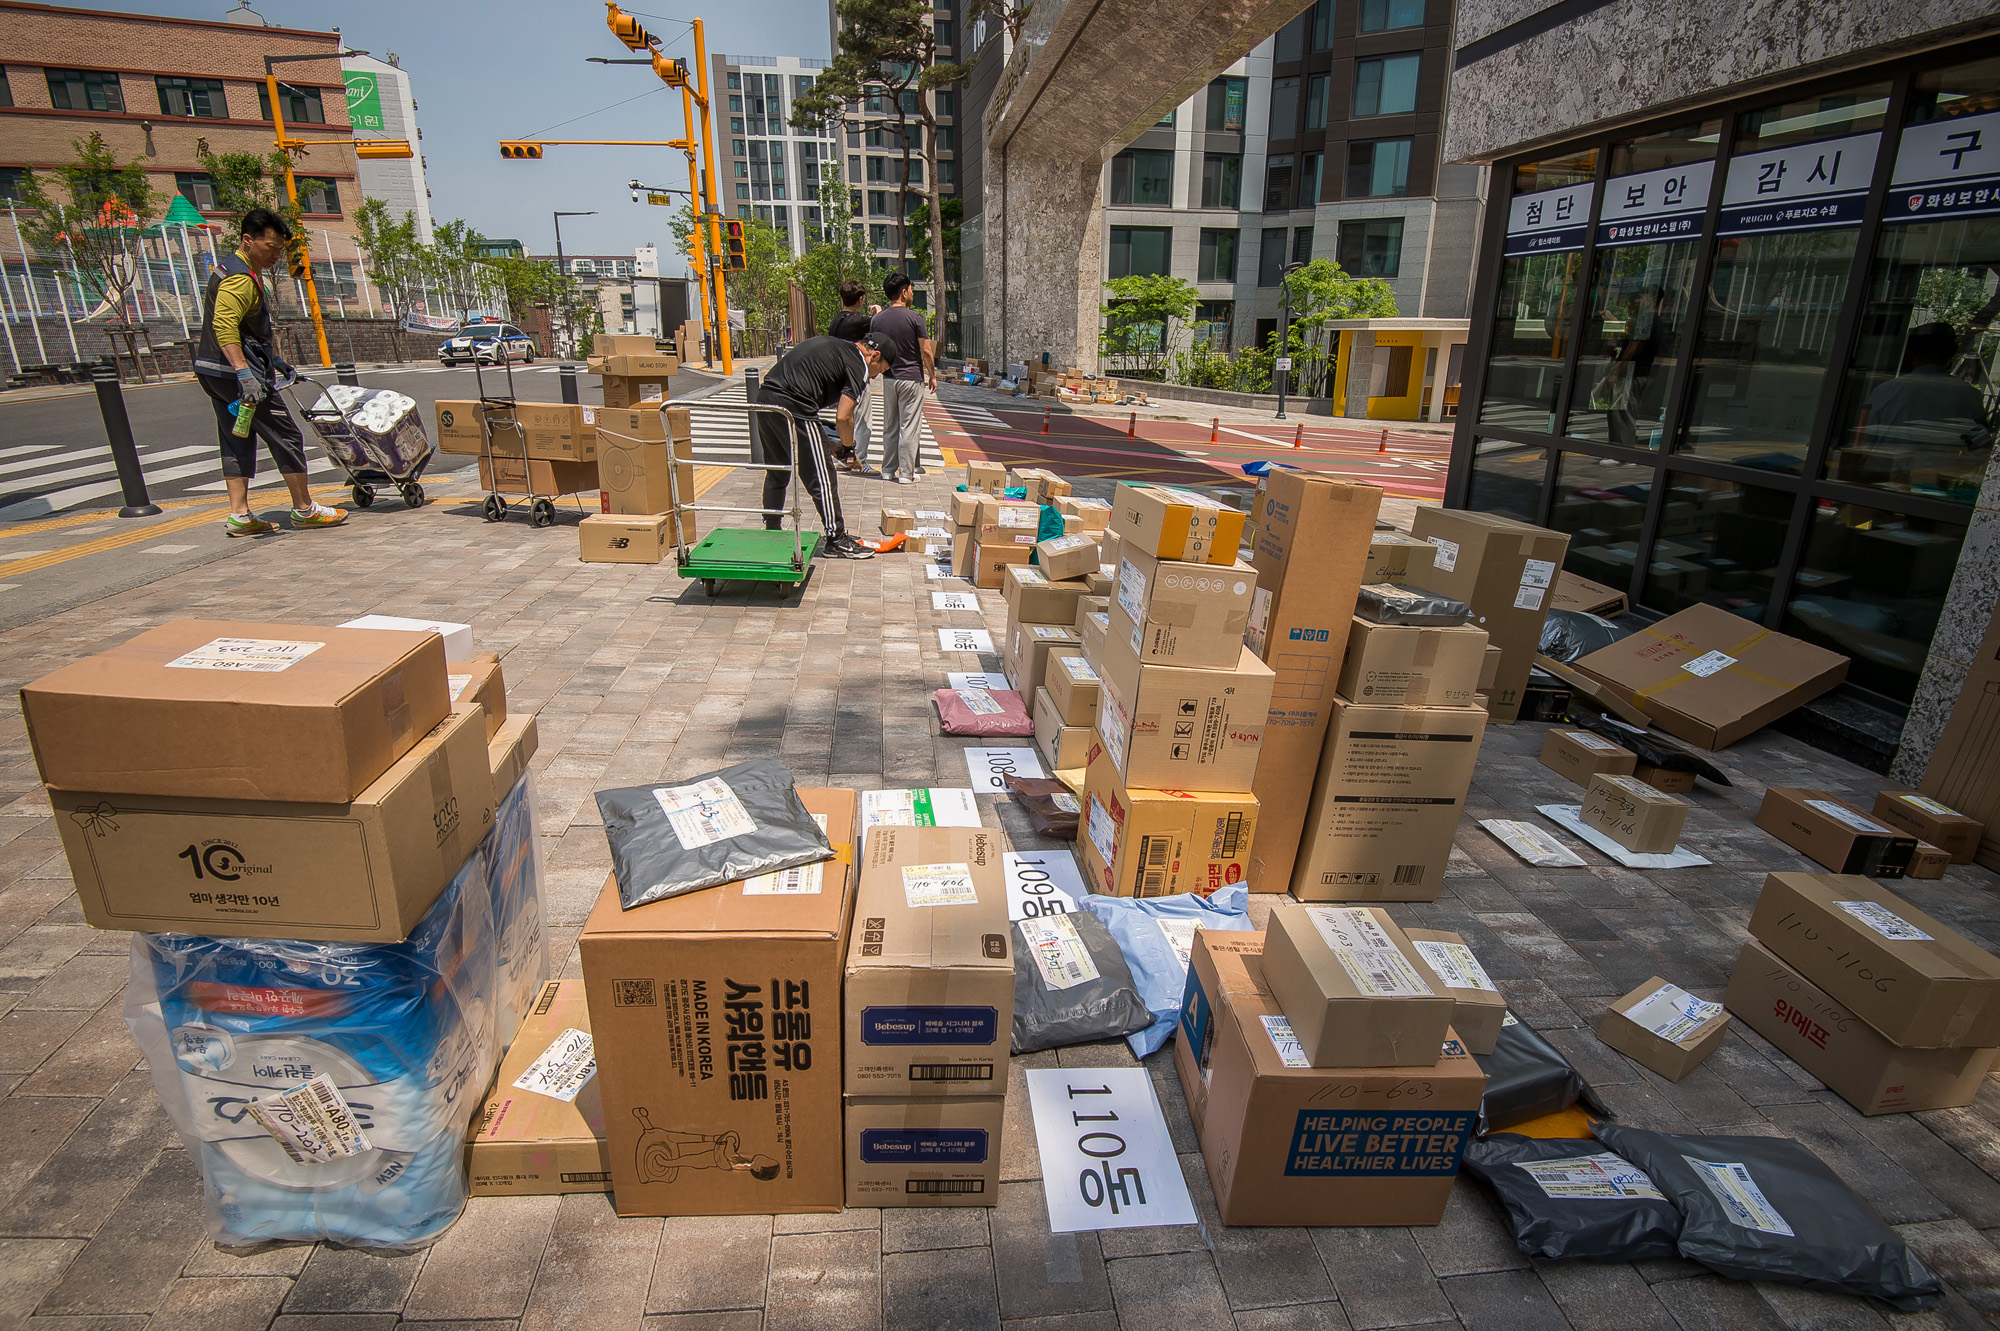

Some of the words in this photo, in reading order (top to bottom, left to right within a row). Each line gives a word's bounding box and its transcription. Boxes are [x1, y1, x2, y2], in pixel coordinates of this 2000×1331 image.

[1939, 129, 1983, 171] 구
[1757, 150, 1842, 195] 감시
[1623, 175, 1687, 209] 보안
[1526, 195, 1574, 226] 첨단
[1740, 213, 1773, 224] PRUGIO
[1785, 208, 1818, 220] 푸르지오
[1819, 204, 1838, 217] 수원
[1618, 222, 1678, 238] 화성보안시스템
[953, 630, 978, 650] 106동
[965, 675, 989, 690] 107
[1237, 732, 1259, 742] Nuts
[1586, 806, 1634, 835] 109-1106
[974, 833, 987, 867] Bebesup
[231, 864, 273, 876] original
[1014, 859, 1065, 917] 109동
[189, 892, 213, 904] 엄마
[215, 894, 250, 905] 생각만
[252, 896, 280, 907] 10년
[1776, 912, 1897, 994] 110-1106
[265, 990, 304, 1004] 깨끗한
[692, 980, 709, 1020] MADE
[696, 1022, 711, 1035] IN
[770, 978, 812, 1072] 프롬유
[874, 1021, 916, 1032] Bebesup
[1773, 998, 1831, 1051] 위메프
[724, 977, 769, 1102] 샤워핸들
[697, 1037, 714, 1081] KOREA
[252, 1063, 316, 1080] 클린케어
[1308, 1079, 1435, 1102] 110-603
[1303, 1117, 1388, 1132] HELPING
[1392, 1117, 1467, 1132] PEOPLE
[873, 1143, 912, 1151] Bebesup
[1067, 1084, 1147, 1215] 110동
[1299, 1134, 1357, 1153] LIVE
[1364, 1134, 1459, 1153] BETTER
[376, 1160, 404, 1185] NEW
[1293, 1155, 1396, 1171] HEALTHIER
[1400, 1155, 1454, 1170] LIVES
